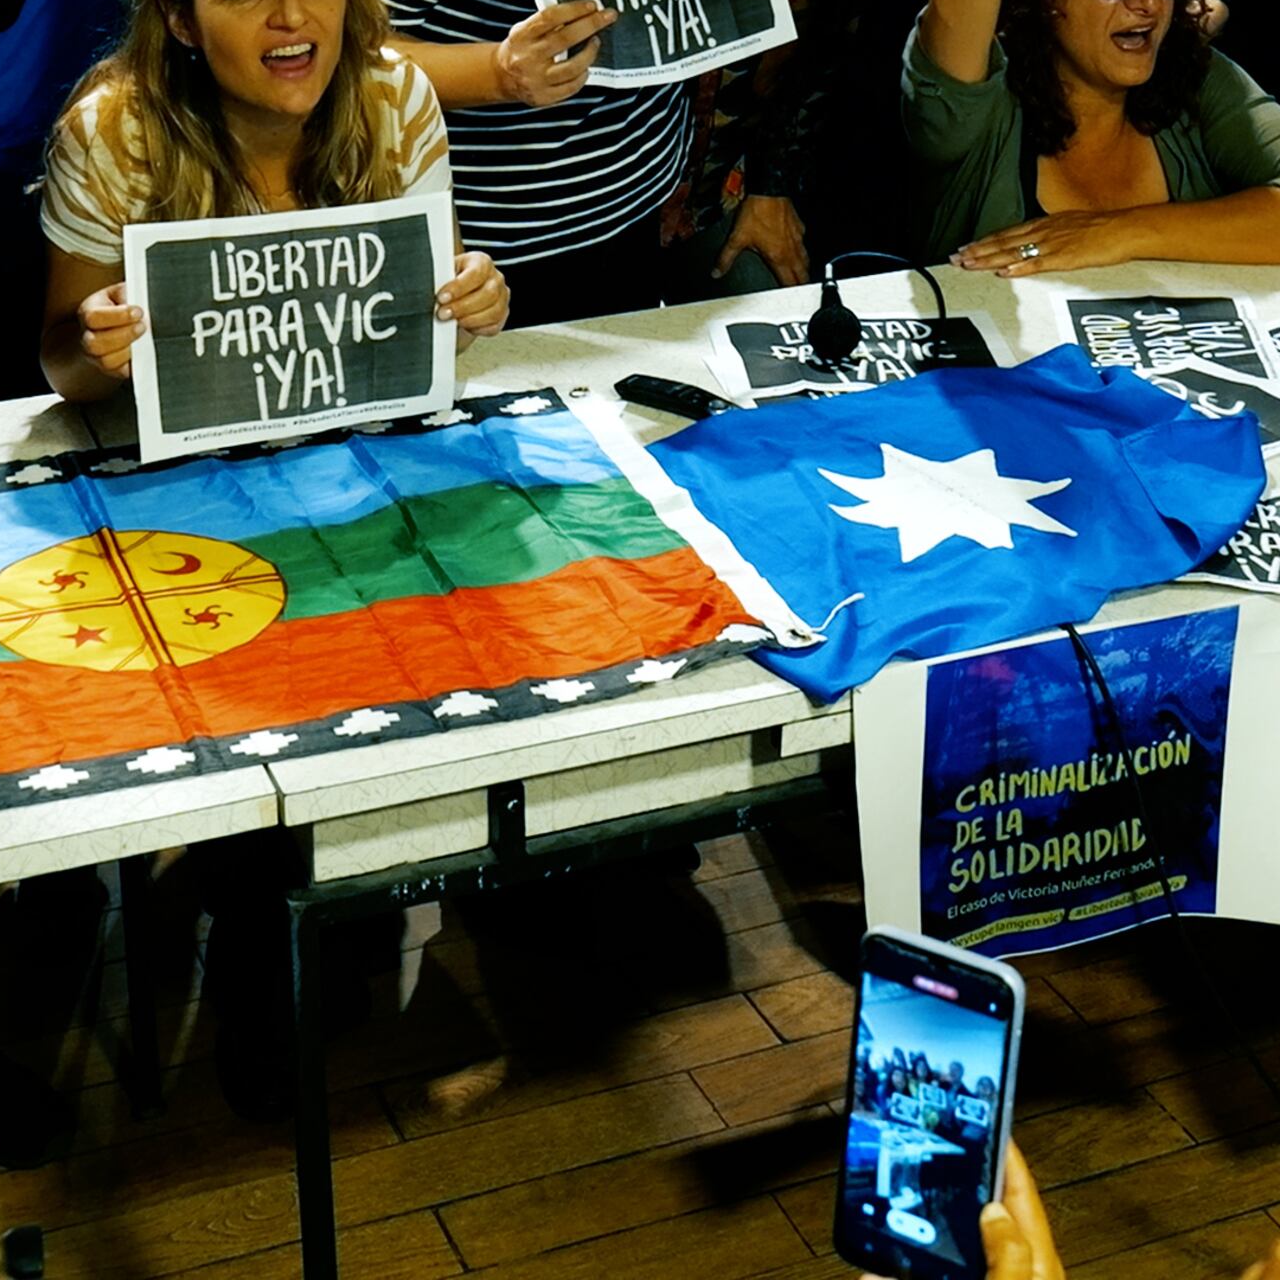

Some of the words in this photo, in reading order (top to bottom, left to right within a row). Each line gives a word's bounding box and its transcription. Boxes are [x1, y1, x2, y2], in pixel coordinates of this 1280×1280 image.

[210, 232, 386, 302] LIBERTAD
[191, 298, 308, 358] PARA
[314, 290, 398, 345] VIC
[252, 343, 348, 421] ¡YA!
[951, 816, 986, 854] DE
[996, 807, 1023, 842] LA
[947, 905, 959, 919] El
[960, 896, 987, 916] caso
[989, 888, 1006, 905] de
[1008, 879, 1059, 902] Victoria
[1061, 874, 1101, 891] Nuñez
